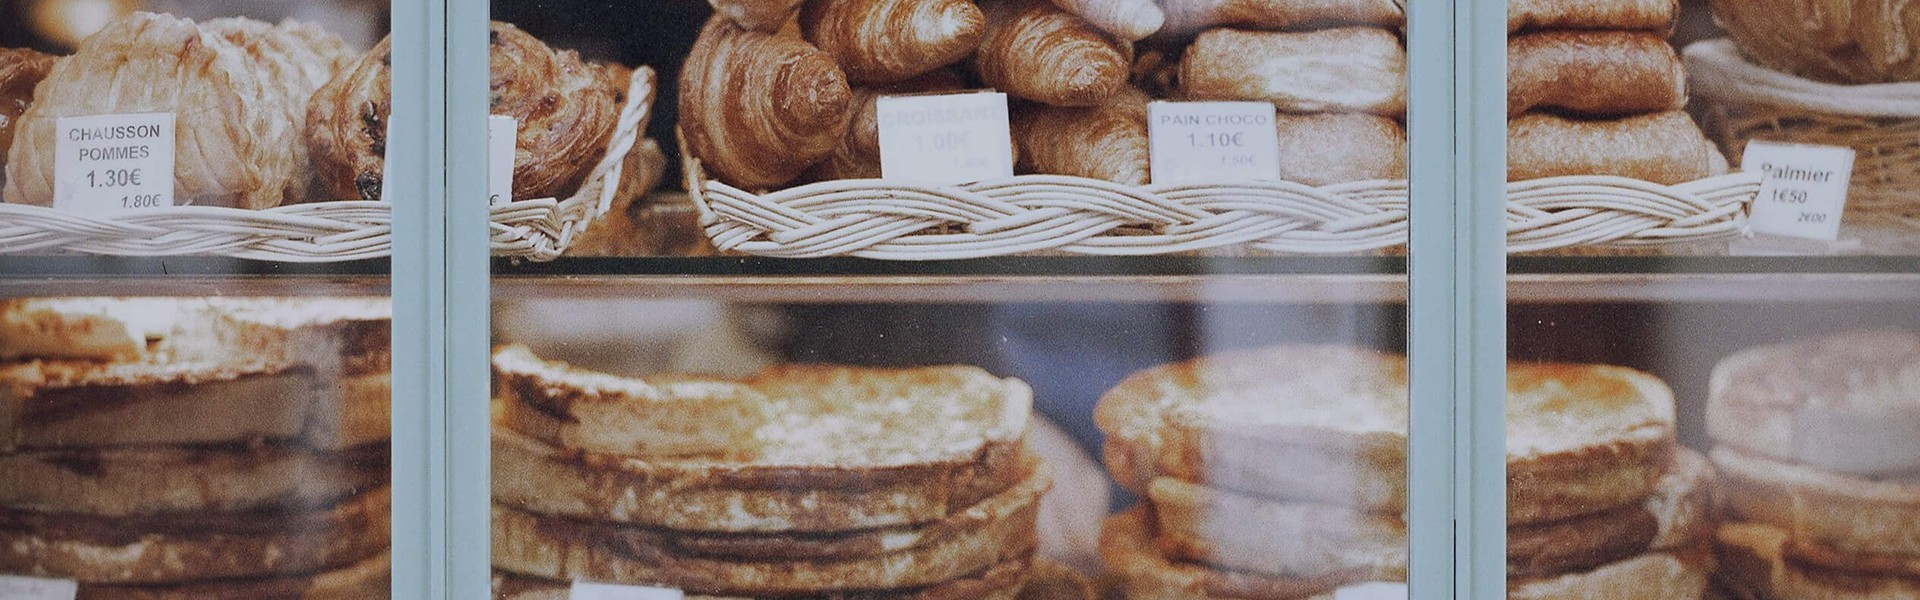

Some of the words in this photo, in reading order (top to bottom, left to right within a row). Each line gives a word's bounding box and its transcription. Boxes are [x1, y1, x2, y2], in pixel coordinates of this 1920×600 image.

[1161, 114, 1199, 125] PAIN
[1205, 114, 1267, 126] CHOCO
[69, 125, 160, 141] CHAUSSON
[1187, 132, 1244, 147] 1.10€
[79, 145, 149, 161] POMMES
[87, 168, 141, 188] 1.30€
[121, 194, 161, 208] 1.80€
[1772, 188, 1808, 204] 1€50
